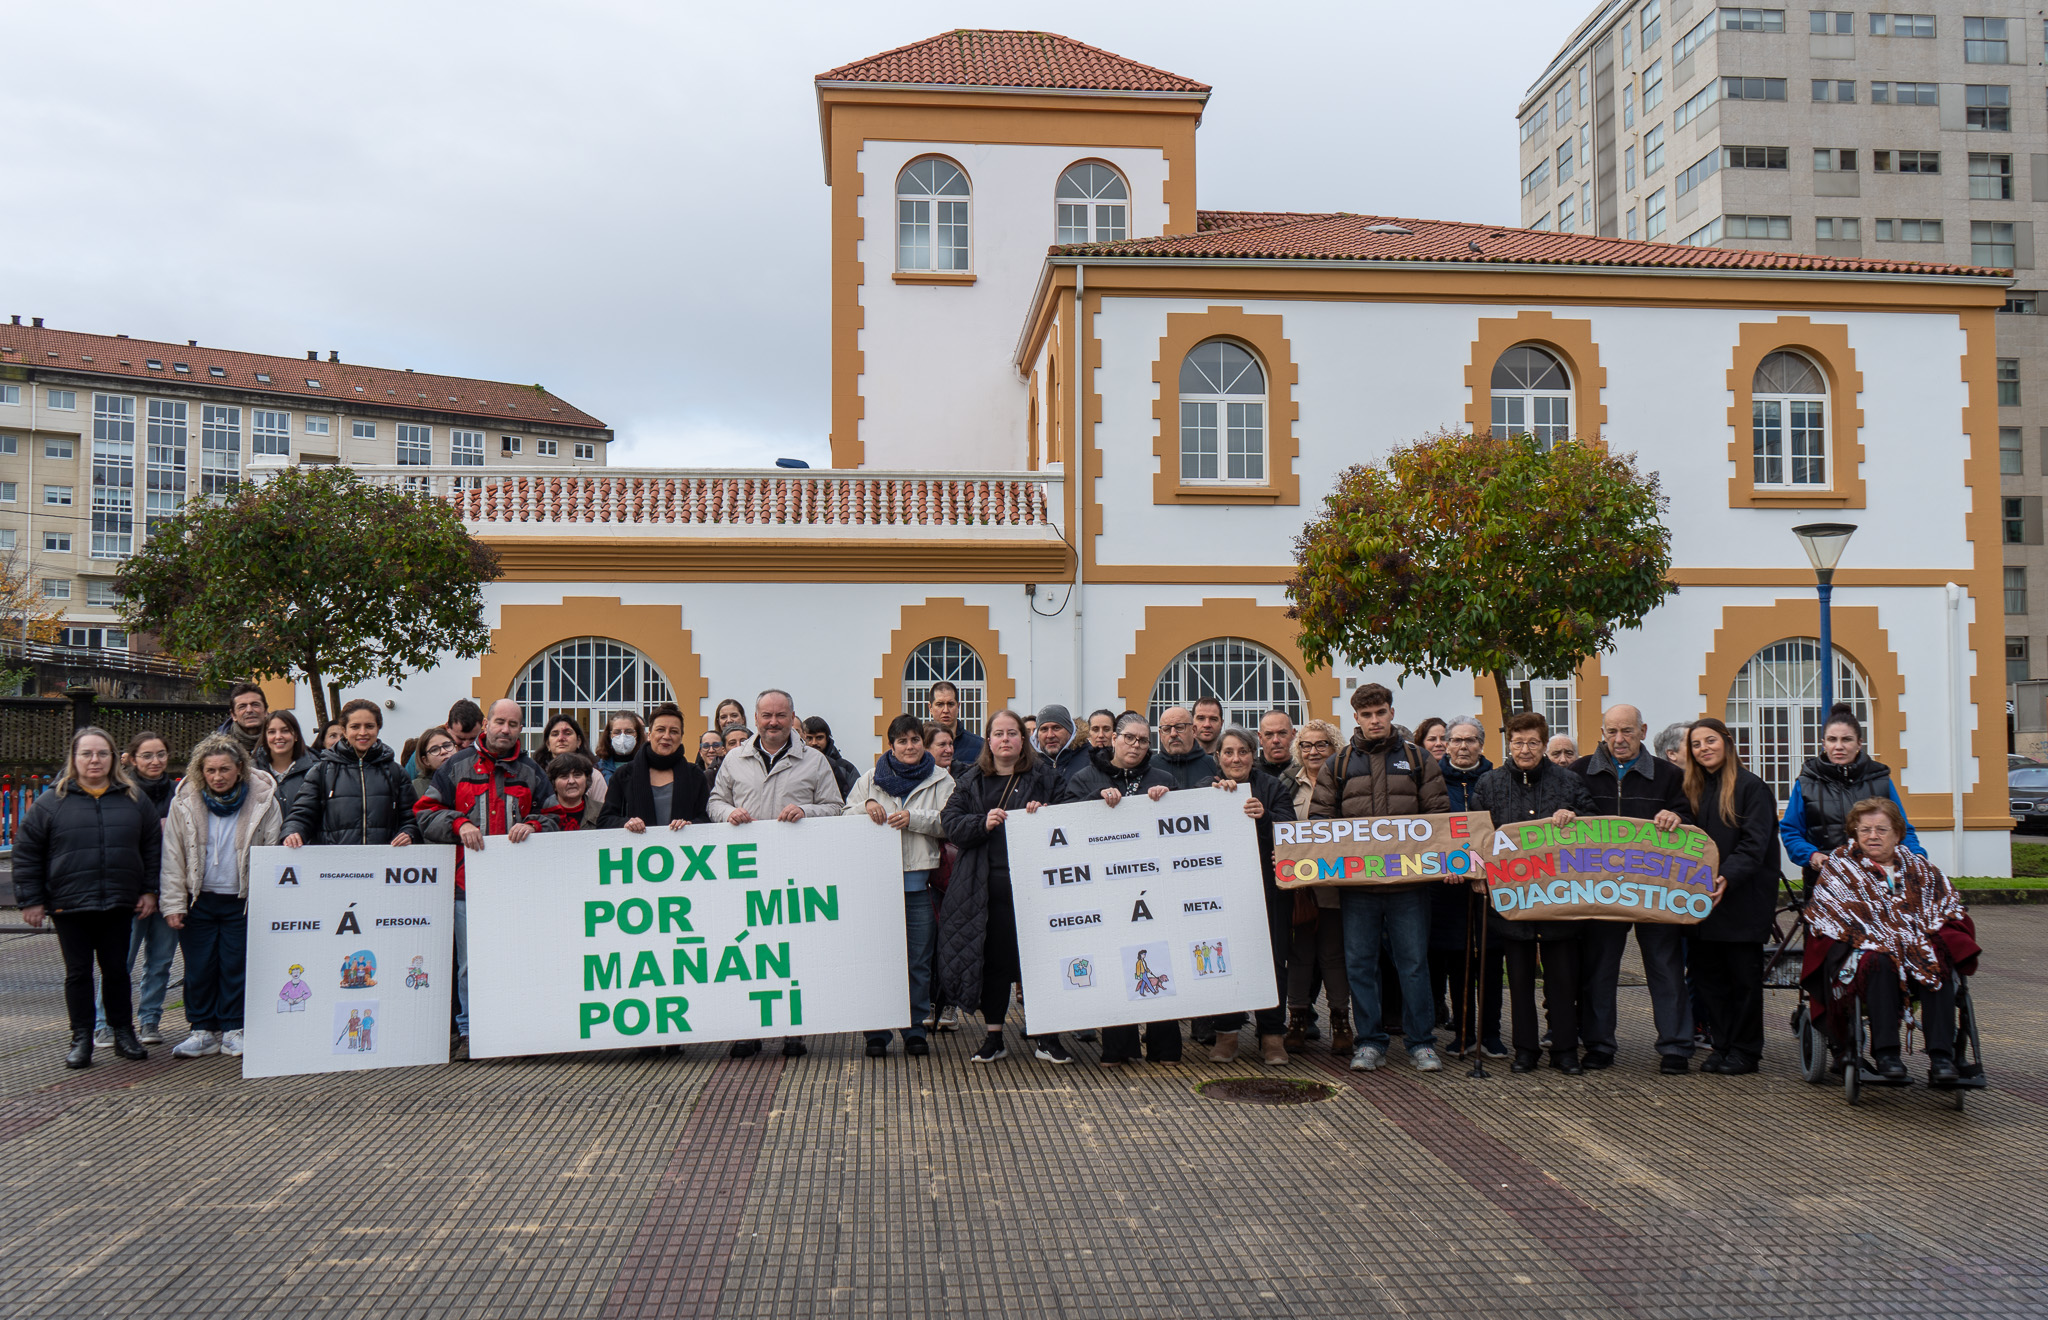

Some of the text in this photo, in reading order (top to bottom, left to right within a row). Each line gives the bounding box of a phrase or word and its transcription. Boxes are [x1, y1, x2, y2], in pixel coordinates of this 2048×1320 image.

[1049, 814, 1211, 847] A DISCAPACIDADE NON
[1274, 815, 1471, 845] RESPECTO E
[1492, 819, 1708, 858] A DIGNIDADE
[278, 866, 299, 886] A
[385, 867, 438, 884] NON
[598, 843, 759, 886] HOXE
[1042, 854, 1224, 887] TEN LÍMITES, PÓDESE
[1485, 847, 1714, 892] NON NECESITA
[1049, 890, 1223, 929] CHEGAR Á META.
[1492, 874, 1714, 919] DIAGNÓSTICO
[271, 902, 431, 936] DEFINE Á PERSONA.
[584, 896, 694, 938] POR
[583, 929, 791, 992] MAÑÁN
[579, 996, 693, 1040] POR
